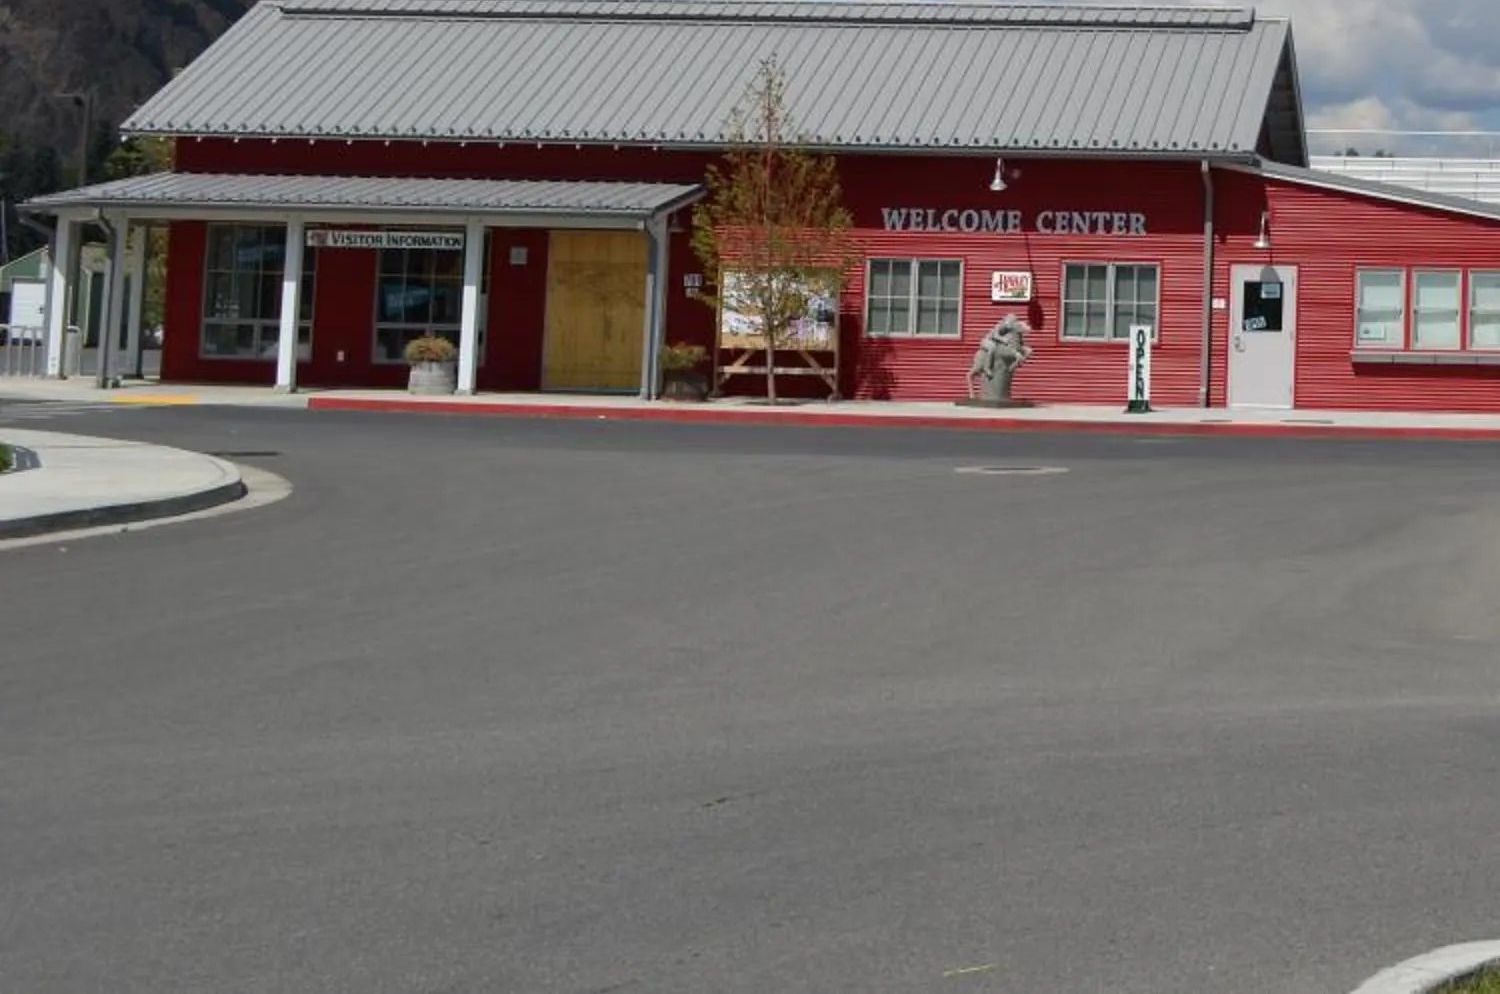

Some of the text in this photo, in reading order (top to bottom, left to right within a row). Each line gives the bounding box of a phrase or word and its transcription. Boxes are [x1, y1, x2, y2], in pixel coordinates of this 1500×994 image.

[881, 207, 1147, 236] WELCOME CENTER
[331, 232, 461, 248] VISITOR INFORMATION
[1135, 329, 1146, 399] OPEN
